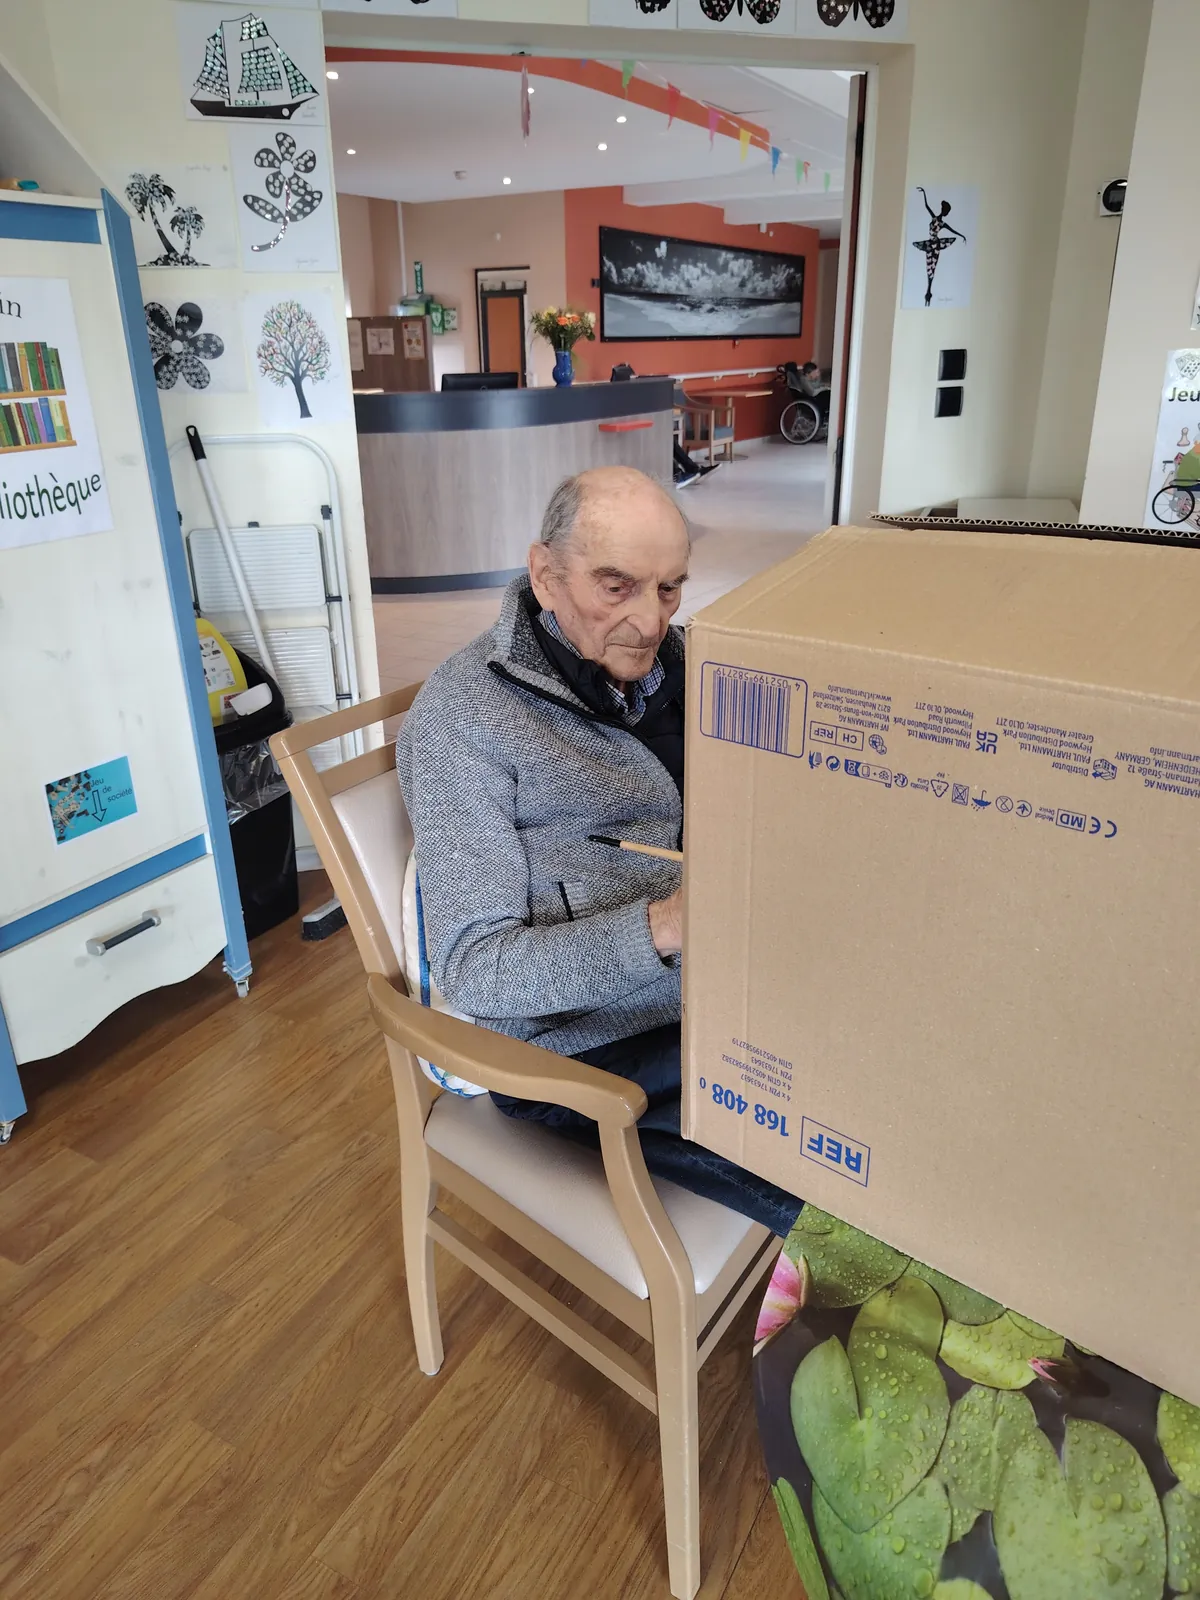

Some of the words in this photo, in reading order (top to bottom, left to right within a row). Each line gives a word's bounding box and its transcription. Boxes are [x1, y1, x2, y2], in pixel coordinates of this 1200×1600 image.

[716, 667, 749, 680] 582719
[753, 674, 788, 689] 052199
[795, 682, 800, 691] 4
[813, 691, 843, 704] Switzerland
[845, 697, 876, 710] Neuhausen,
[878, 704, 891, 712] 8212
[914, 702, 926, 710] 2TT
[927, 704, 942, 713] OL10
[824, 702, 890, 722] Victor-von-Bruns-Strasse
[944, 706, 974, 720] Heywood,
[847, 717, 879, 729] HARTMANN
[893, 716, 906, 726] Park
[928, 714, 943, 724] Road
[944, 718, 972, 730] Pilsworth
[996, 717, 1008, 726] 2TT
[880, 724, 889, 732] IVF
[907, 720, 942, 733] Distribution
[1009, 720, 1024, 730] OL10
[1026, 722, 1067, 738] Manchester,
[814, 728, 833, 739] REP
[907, 729, 918, 738] Ltd.
[943, 726, 972, 739] Heywood
[976, 730, 998, 743] CA
[1002, 729, 1018, 738] Park
[1068, 732, 1094, 743] Greater
[843, 733, 857, 744] CH
[919, 732, 953, 745] HARTMANN
[954, 739, 970, 749] PAUL
[1019, 732, 1058, 746] Distribution
[975, 740, 996, 754] UK
[1018, 742, 1031, 752] Ltd.
[1032, 745, 1072, 760] HARTMANN
[1059, 740, 1092, 754] Heywood
[1073, 752, 1091, 764] PAUL
[1114, 752, 1150, 766] GERMANY
[1052, 762, 1088, 776] Distributor
[1128, 764, 1135, 774] 12
[91, 778, 104, 787] Jeu
[1144, 778, 1155, 788] AG
[102, 785, 112, 793] de
[108, 788, 132, 802] société
[1038, 807, 1054, 815] Device
[1035, 813, 1054, 822] Medical
[1060, 814, 1083, 828] MD
[778, 1058, 792, 1069] GTIN
[768, 1075, 781, 1086] GTIN
[780, 1070, 792, 1080] PZN
[769, 1087, 780, 1097] PZN
[712, 1084, 748, 1115] 408
[754, 1104, 789, 1136] 168
[807, 1133, 862, 1174] REF
